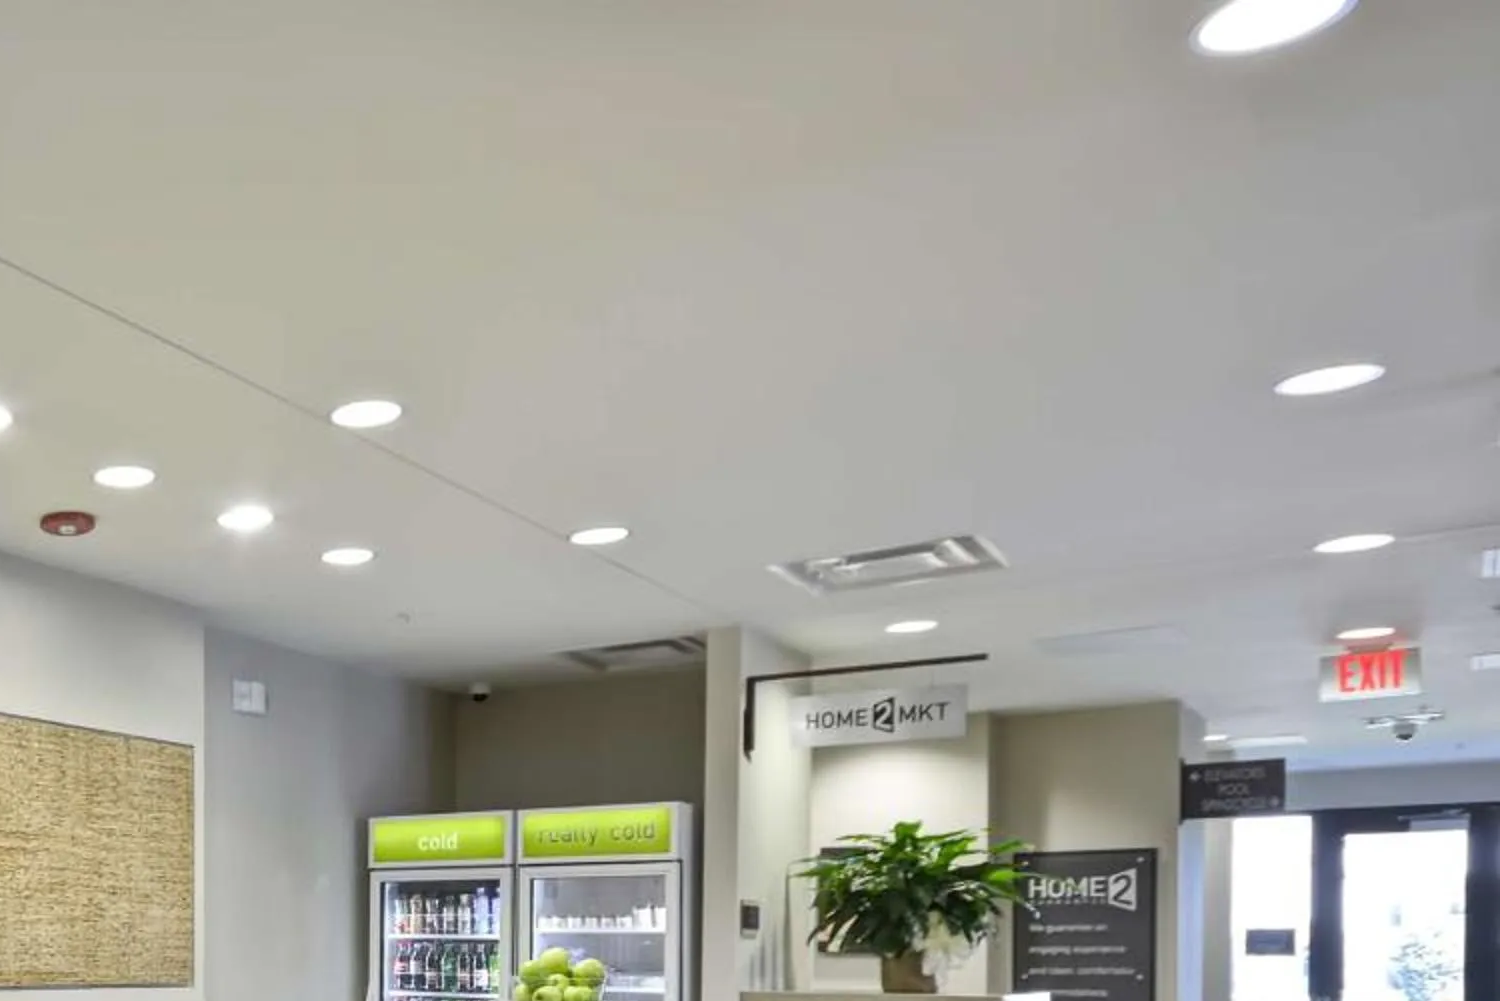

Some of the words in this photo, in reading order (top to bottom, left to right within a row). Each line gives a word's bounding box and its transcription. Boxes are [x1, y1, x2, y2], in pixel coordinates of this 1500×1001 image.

[1337, 649, 1408, 693] EXIT
[899, 701, 950, 724] MKT
[417, 832, 459, 851] cold
[538, 826, 598, 847] really
[610, 822, 656, 842] cold
